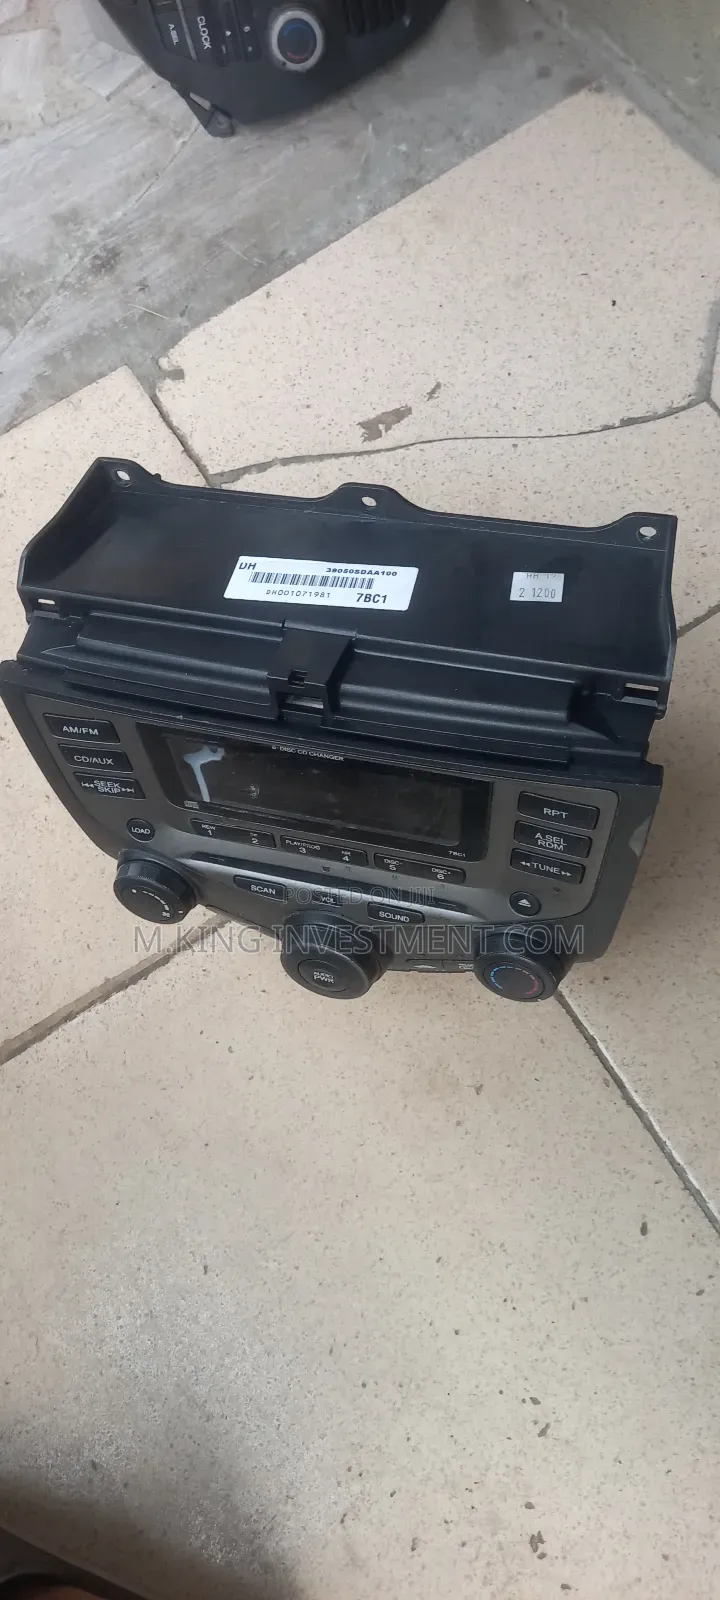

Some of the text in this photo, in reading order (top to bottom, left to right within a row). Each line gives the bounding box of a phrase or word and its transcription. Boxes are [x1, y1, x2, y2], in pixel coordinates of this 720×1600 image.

[197, 16, 211, 50] CLOCK
[238, 562, 257, 571] DH
[355, 593, 388, 604] 7BC1
[518, 587, 556, 599] 2 1200
[62, 725, 99, 736] AM/FM
[73, 755, 115, 766] CD/AUX
[309, 751, 344, 761] CHANGER
[93, 779, 121, 789] SEEK
[97, 786, 121, 794] SKIP
[543, 807, 569, 819] RPT
[131, 826, 151, 835] LOAD
[251, 837, 260, 845] 2
[537, 839, 564, 852] RDM
[531, 861, 561, 875] TUNE
[250, 884, 276, 896] SCAN
[378, 910, 410, 923] SOUND
